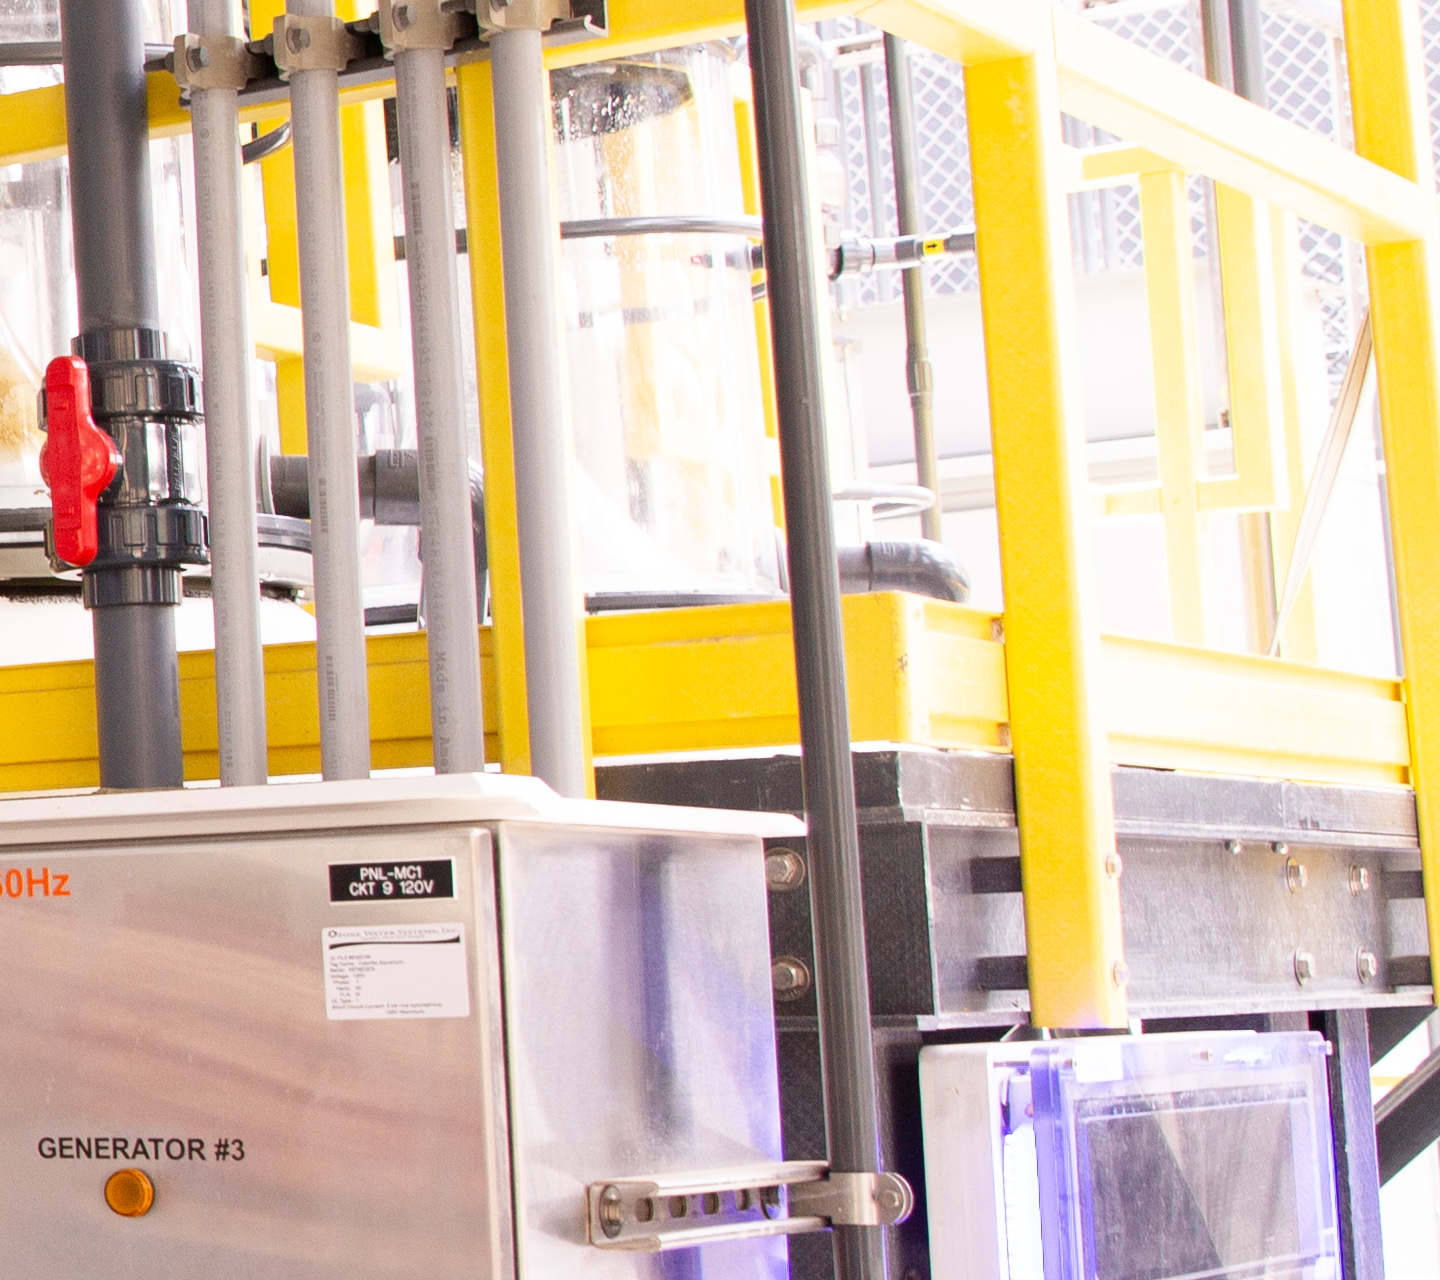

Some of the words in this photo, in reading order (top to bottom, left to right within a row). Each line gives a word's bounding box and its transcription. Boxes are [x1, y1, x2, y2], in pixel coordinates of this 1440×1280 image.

[359, 865, 422, 880] PNL-MC1
[348, 882, 376, 896] CKT
[382, 881, 394, 895] 9
[399, 880, 434, 894] 120V
[37, 1136, 207, 1161] GENERATOR
[215, 1136, 247, 1162] #3
